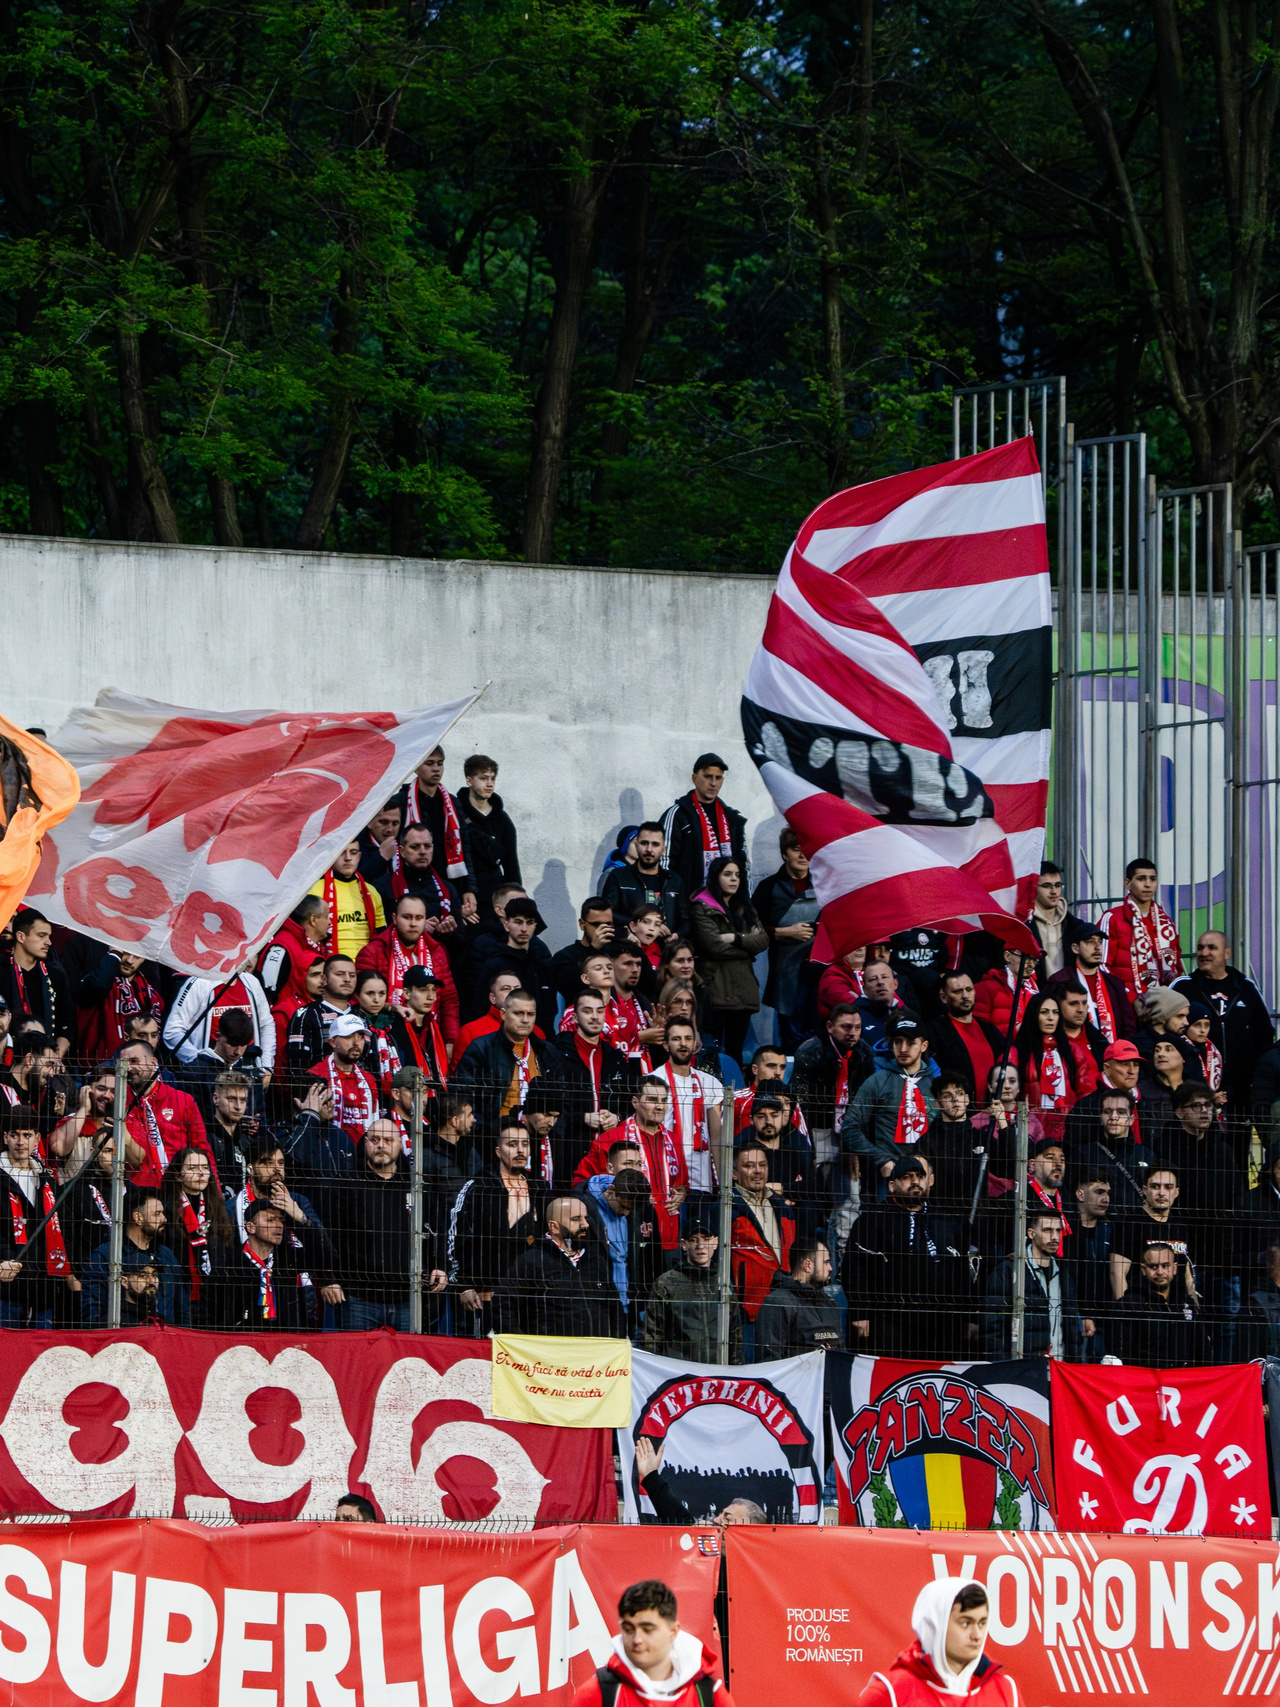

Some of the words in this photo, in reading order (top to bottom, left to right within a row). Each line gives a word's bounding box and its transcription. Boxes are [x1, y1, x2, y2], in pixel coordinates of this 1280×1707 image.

[550, 1389, 567, 1397] nu
[648, 1380, 793, 1436] VETERANII
[1073, 1386, 1252, 1479] FURIA
[843, 1381, 1050, 1508] PANZER
[786, 1607, 851, 1622] PRODUSE
[786, 1624, 831, 1643] 100%
[785, 1645, 863, 1667] ROMÂNEȘTI
